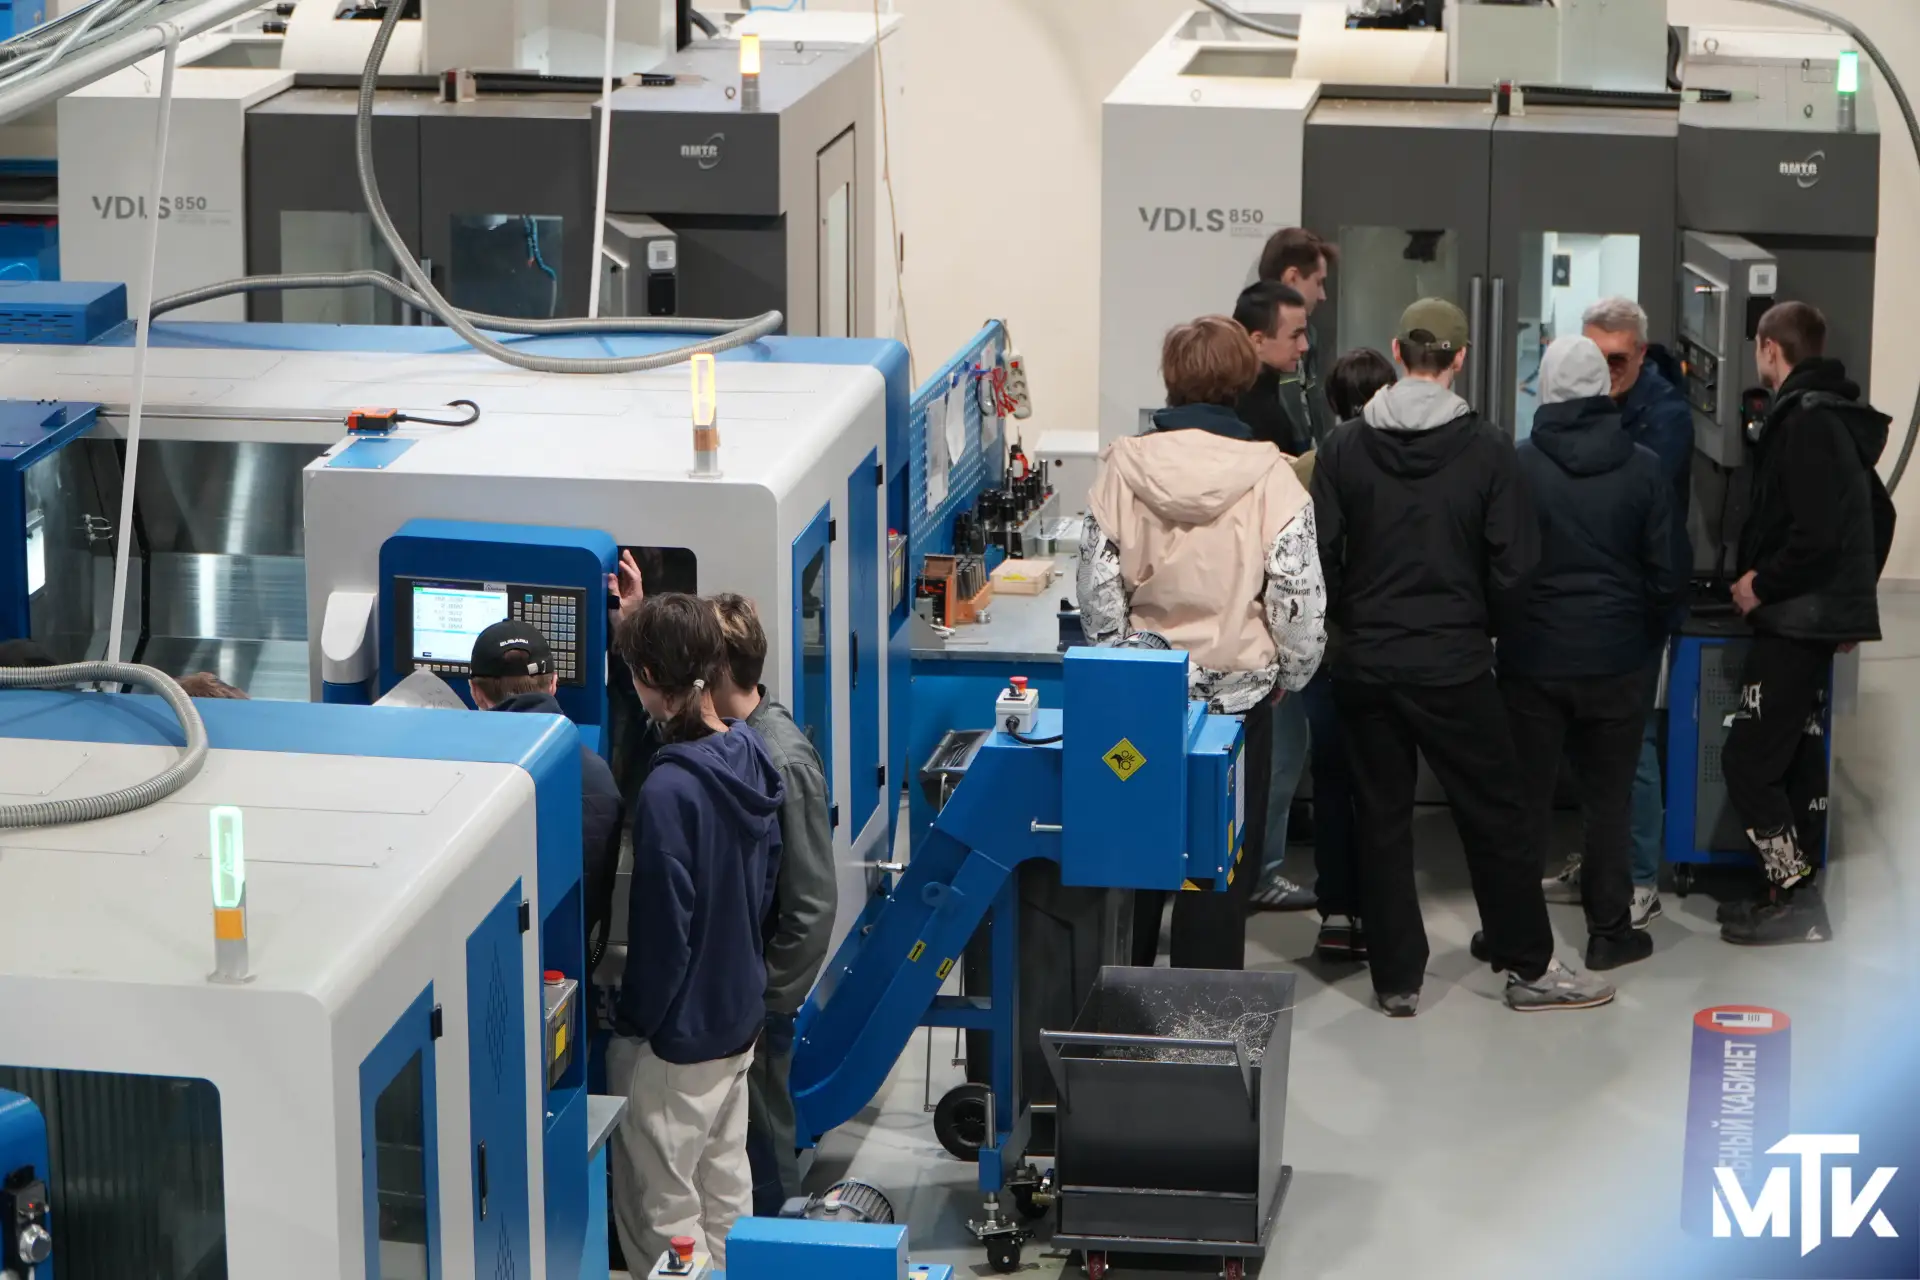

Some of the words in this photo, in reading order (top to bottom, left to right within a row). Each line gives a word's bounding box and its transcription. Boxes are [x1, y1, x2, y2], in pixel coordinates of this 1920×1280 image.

[91, 195, 171, 220] VDLS
[174, 196, 207, 211] 850
[1138, 206, 1225, 232] VDLS
[1229, 209, 1264, 223] 850
[499, 637, 529, 648] SUBARU
[1720, 1040, 1757, 1115] КАБИНЕТ
